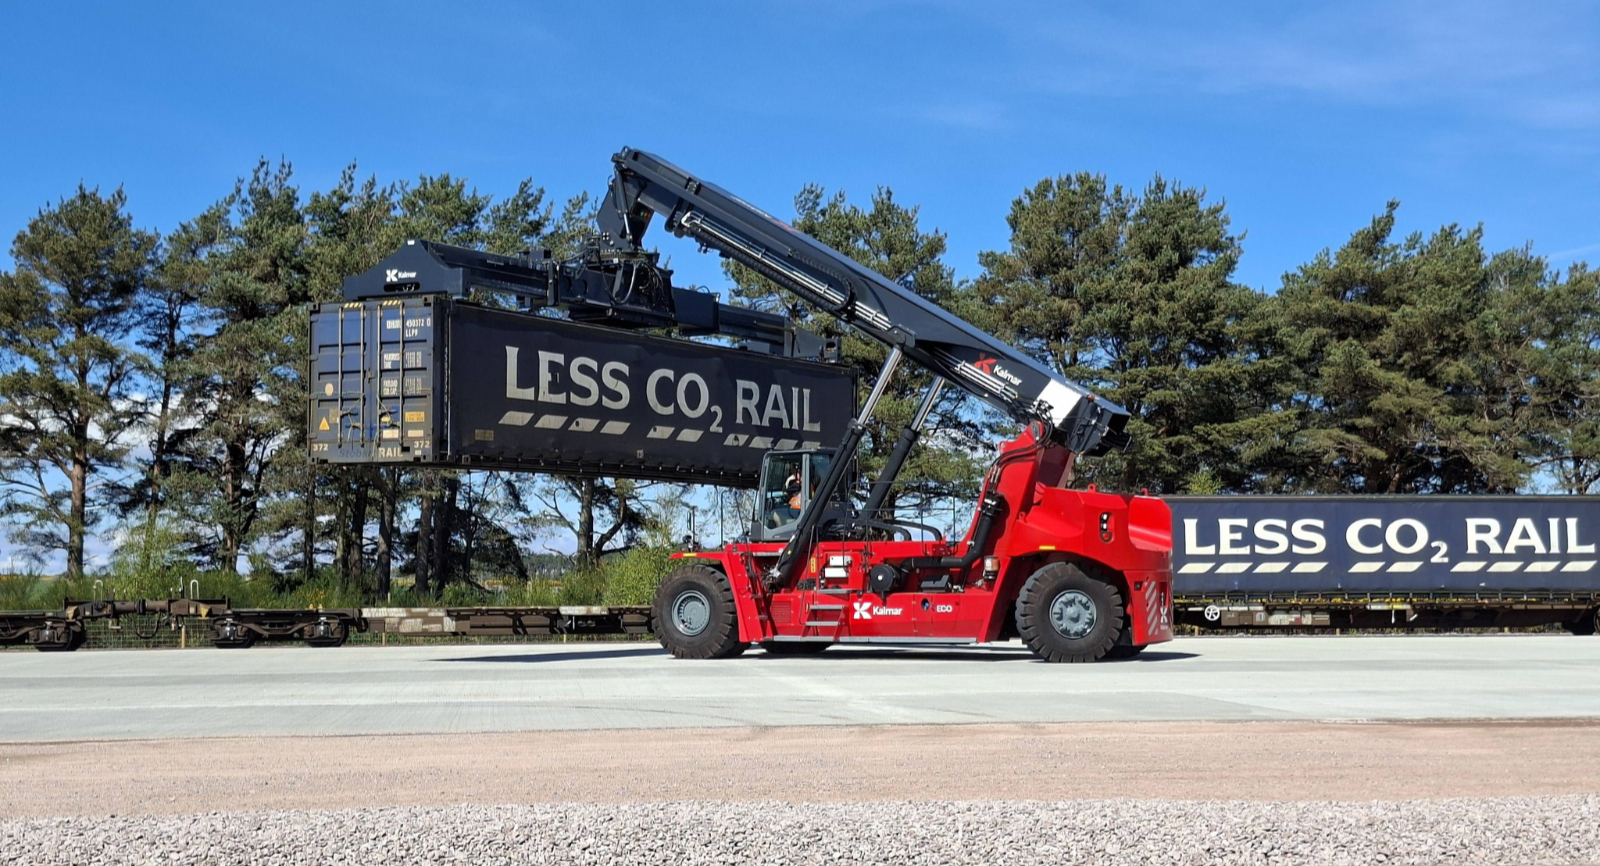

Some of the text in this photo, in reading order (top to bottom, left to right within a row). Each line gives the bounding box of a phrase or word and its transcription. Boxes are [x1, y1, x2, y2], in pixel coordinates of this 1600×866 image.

[398, 270, 417, 279] Kalmar
[993, 364, 1023, 387] Kalmar
[505, 345, 630, 410] LESS
[736, 379, 821, 432] RAIL
[313, 444, 329, 452] 372
[413, 440, 431, 449] 372
[378, 446, 404, 459] RAIL
[1183, 518, 1327, 556] LESS
[1465, 517, 1596, 555] RAIL
[872, 605, 903, 616] Kalmar
[936, 604, 953, 613] ECO
